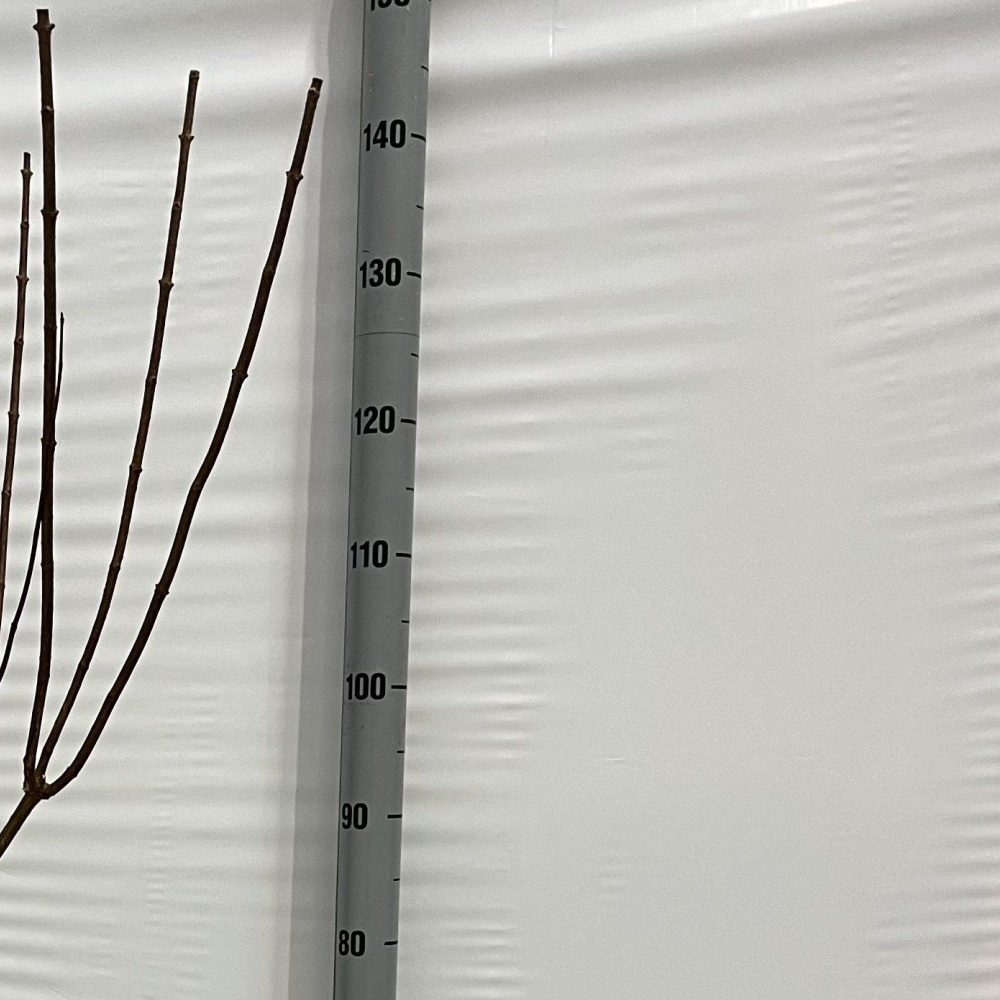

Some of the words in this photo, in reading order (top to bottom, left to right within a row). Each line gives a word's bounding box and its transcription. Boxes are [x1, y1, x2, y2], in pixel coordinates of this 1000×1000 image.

[363, 119, 406, 151] 140
[359, 257, 402, 289] 130
[354, 405, 396, 435] 120
[350, 539, 389, 569] 110
[346, 672, 386, 701] 100
[341, 802, 368, 830] 90
[338, 929, 366, 957] 80
